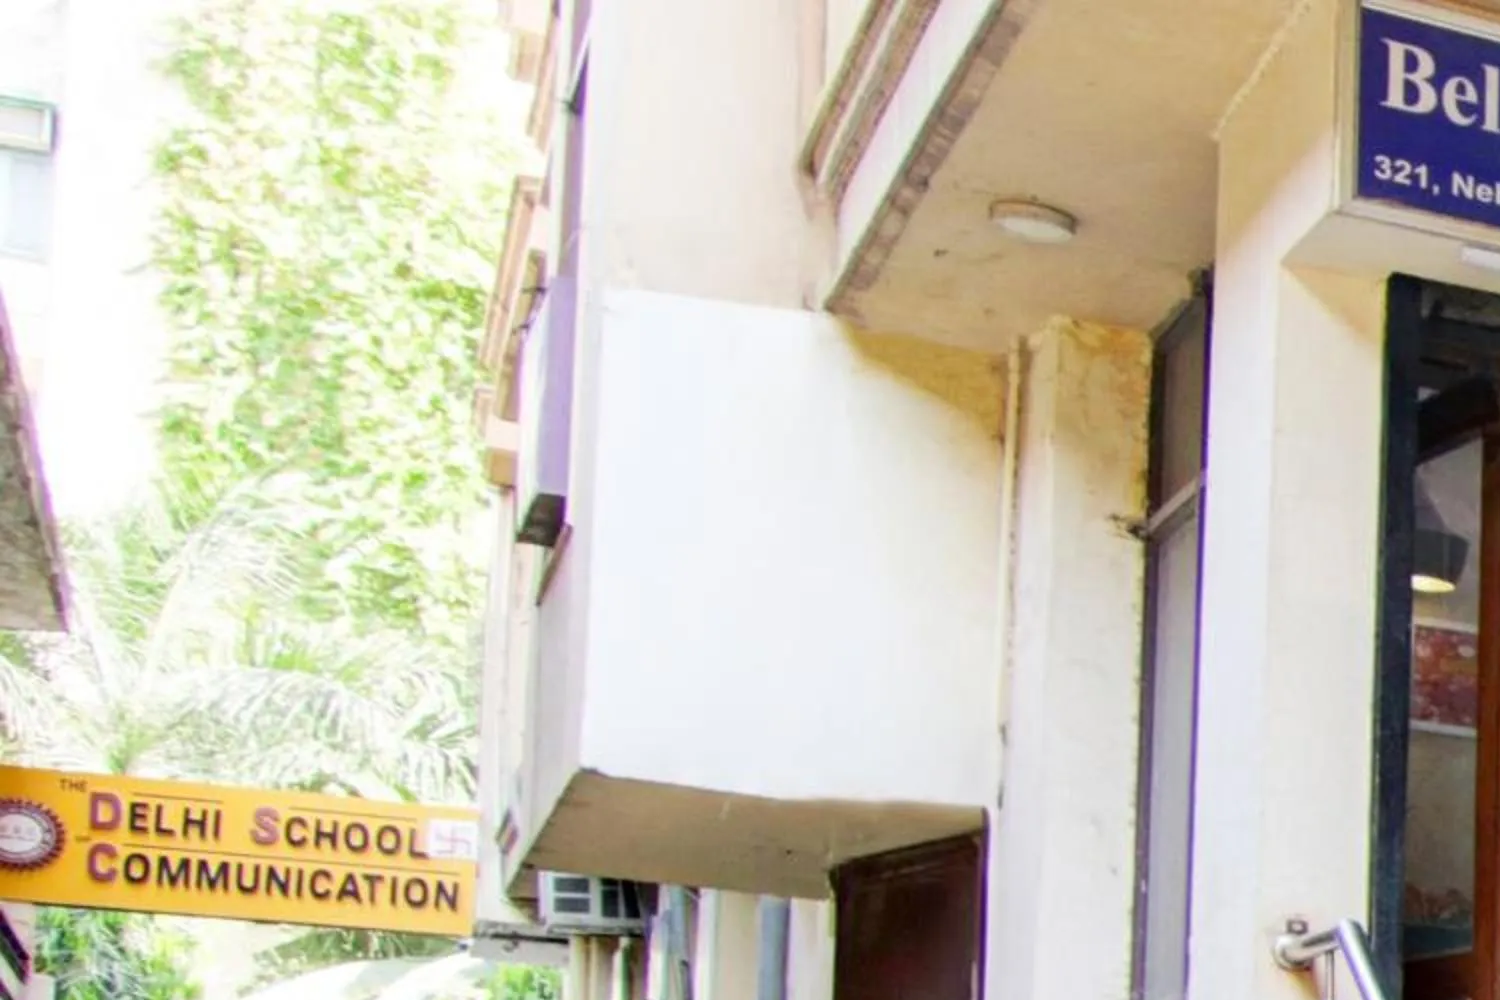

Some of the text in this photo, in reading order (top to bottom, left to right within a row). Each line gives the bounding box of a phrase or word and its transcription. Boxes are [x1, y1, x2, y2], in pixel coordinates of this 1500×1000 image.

[1373, 154, 1440, 195] 321,
[60, 778, 88, 793] THE
[89, 791, 430, 861] DELHI SCHOOL
[87, 842, 460, 914] COMMUNICATION
